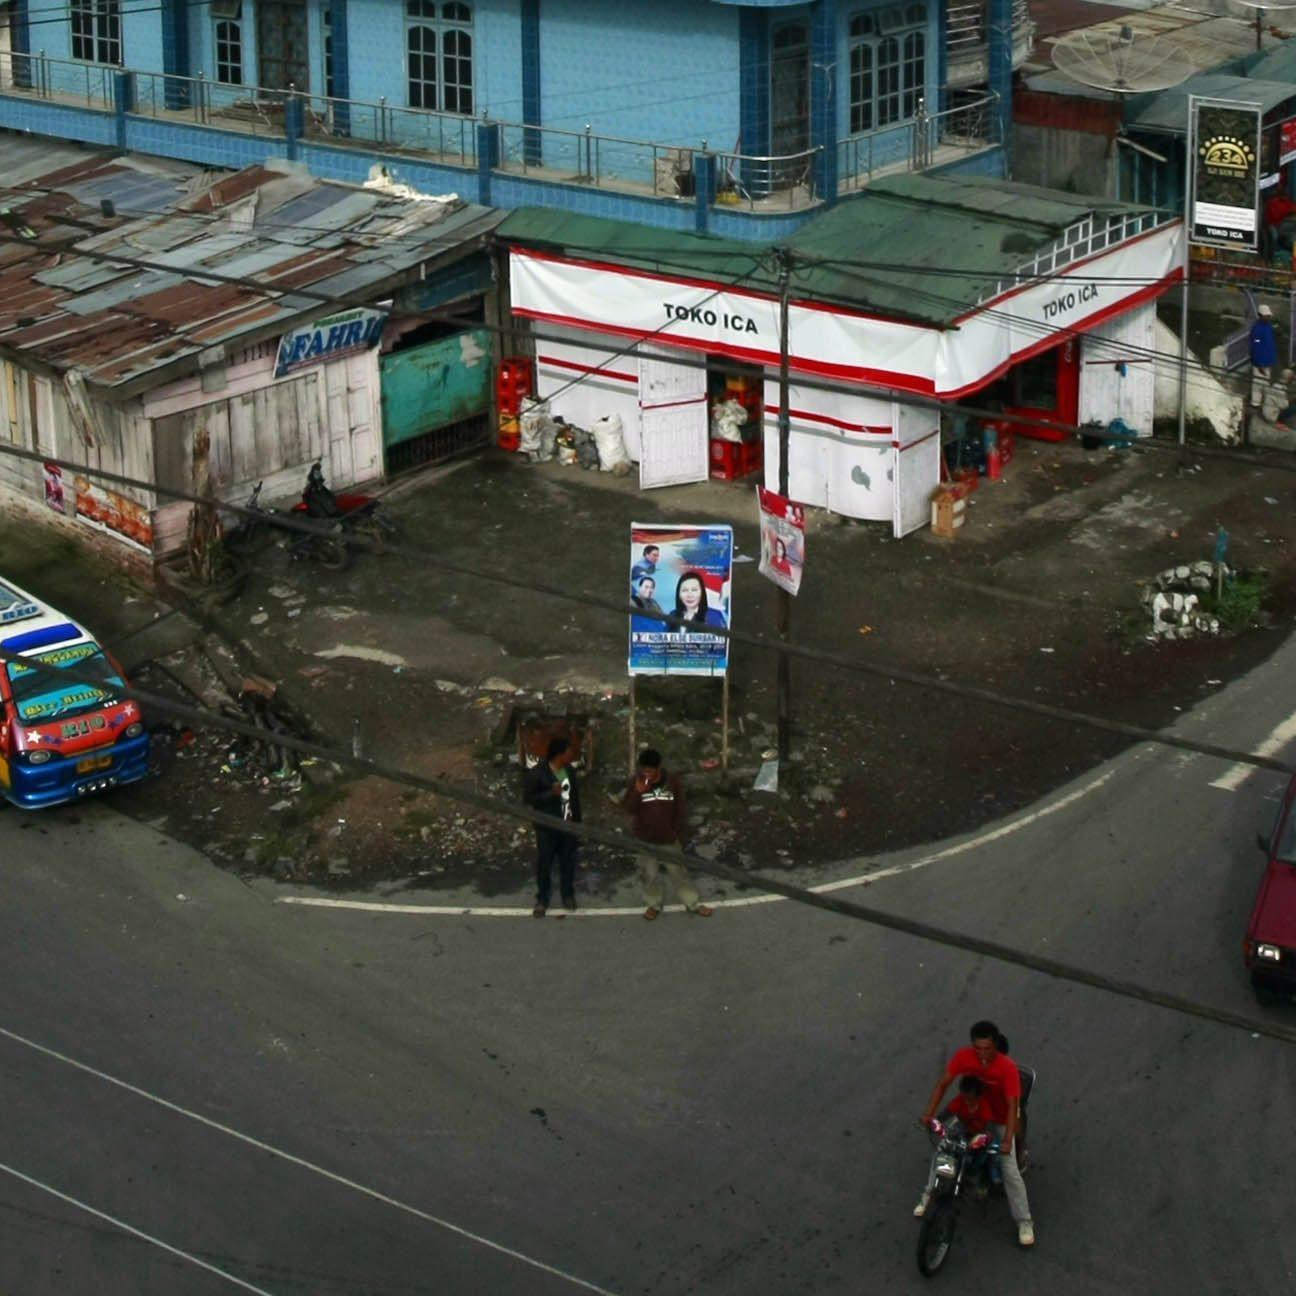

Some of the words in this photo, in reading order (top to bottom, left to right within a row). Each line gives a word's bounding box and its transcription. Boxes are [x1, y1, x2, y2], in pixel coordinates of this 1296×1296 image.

[1210, 149, 1243, 164] 234
[1206, 227, 1229, 237] TOKO
[1229, 231, 1244, 239] ICA
[1042, 292, 1075, 320] TOKO
[1078, 282, 1099, 304] ICA
[663, 303, 717, 326] TOKO
[724, 313, 759, 334] ICA
